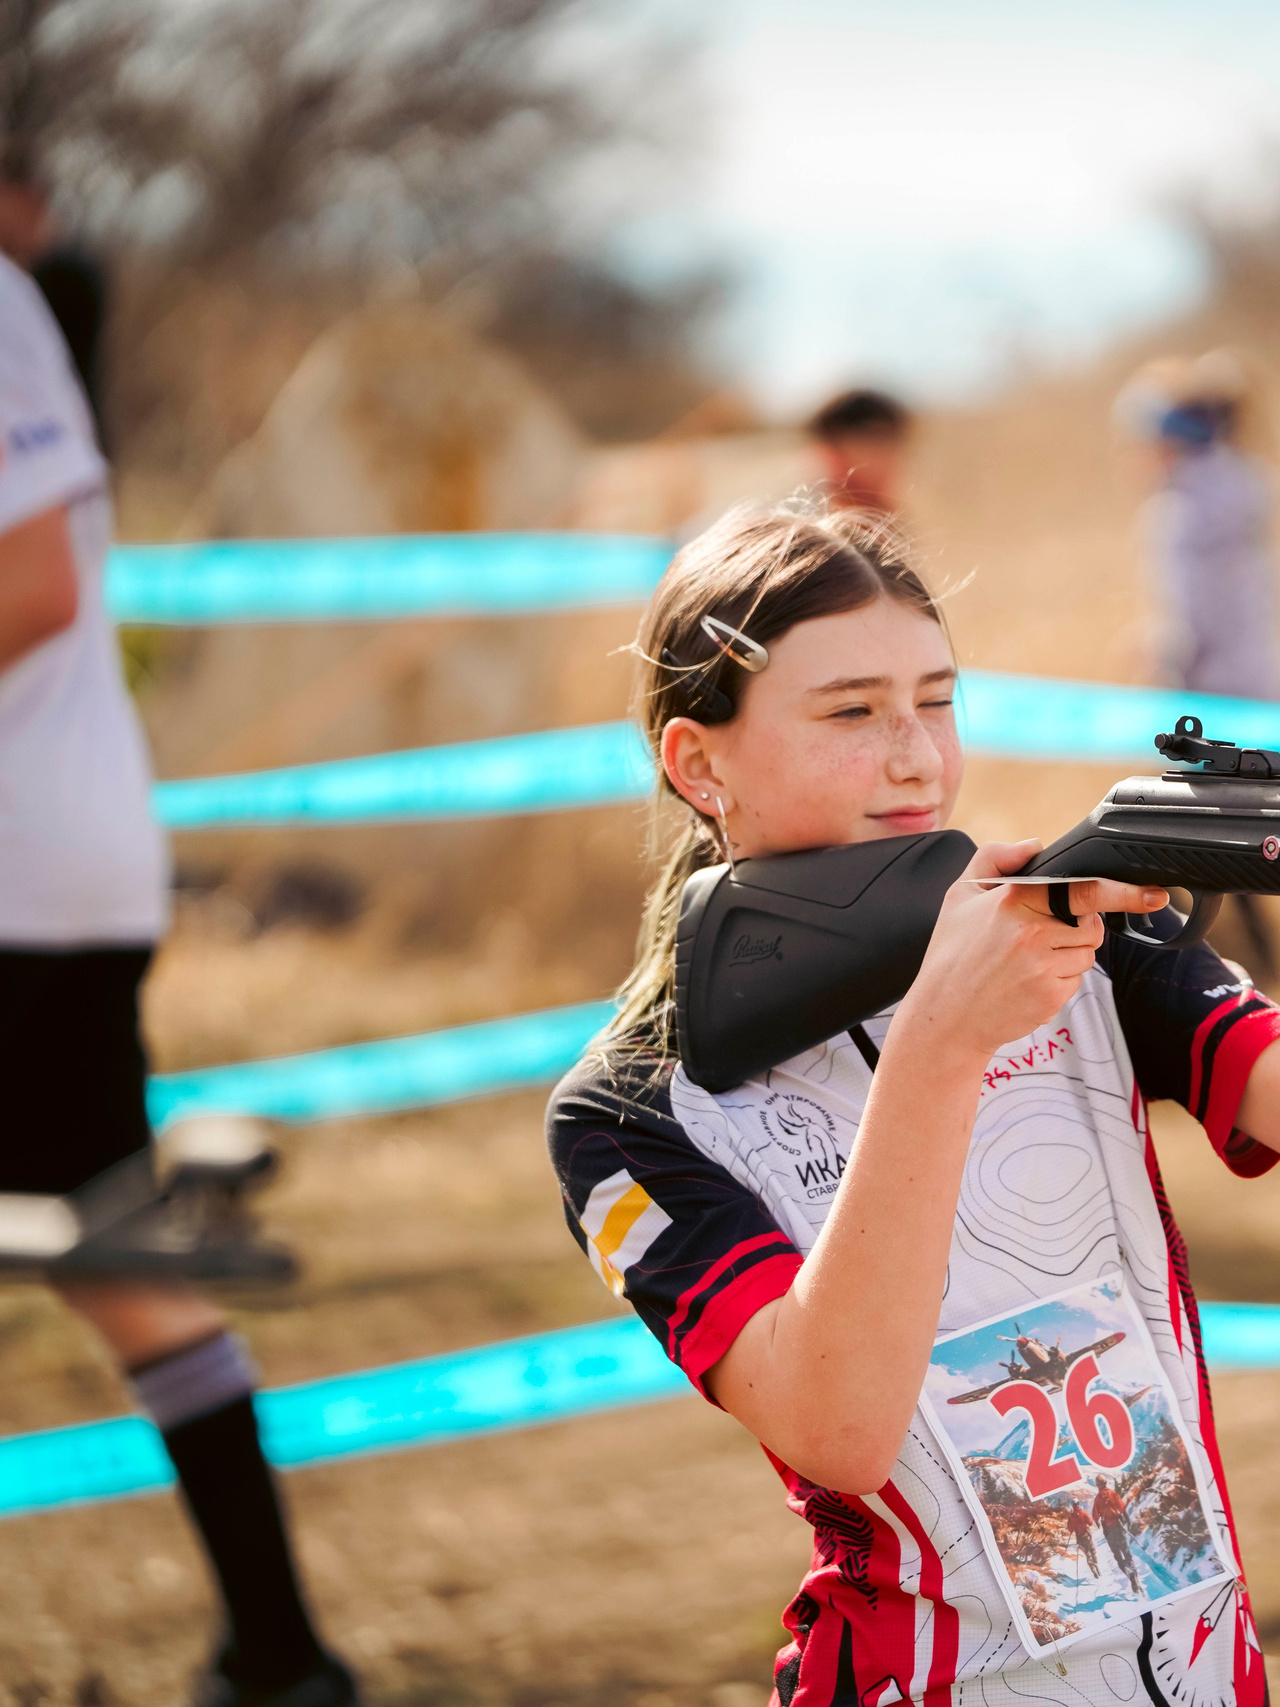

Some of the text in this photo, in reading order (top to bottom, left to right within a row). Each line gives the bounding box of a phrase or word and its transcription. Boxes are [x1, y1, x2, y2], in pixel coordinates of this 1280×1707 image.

[765, 1092, 836, 1132] ОРИТИРОВАНИЕ
[795, 1152, 850, 1187] ИКА
[987, 1351, 1135, 1502] 26
